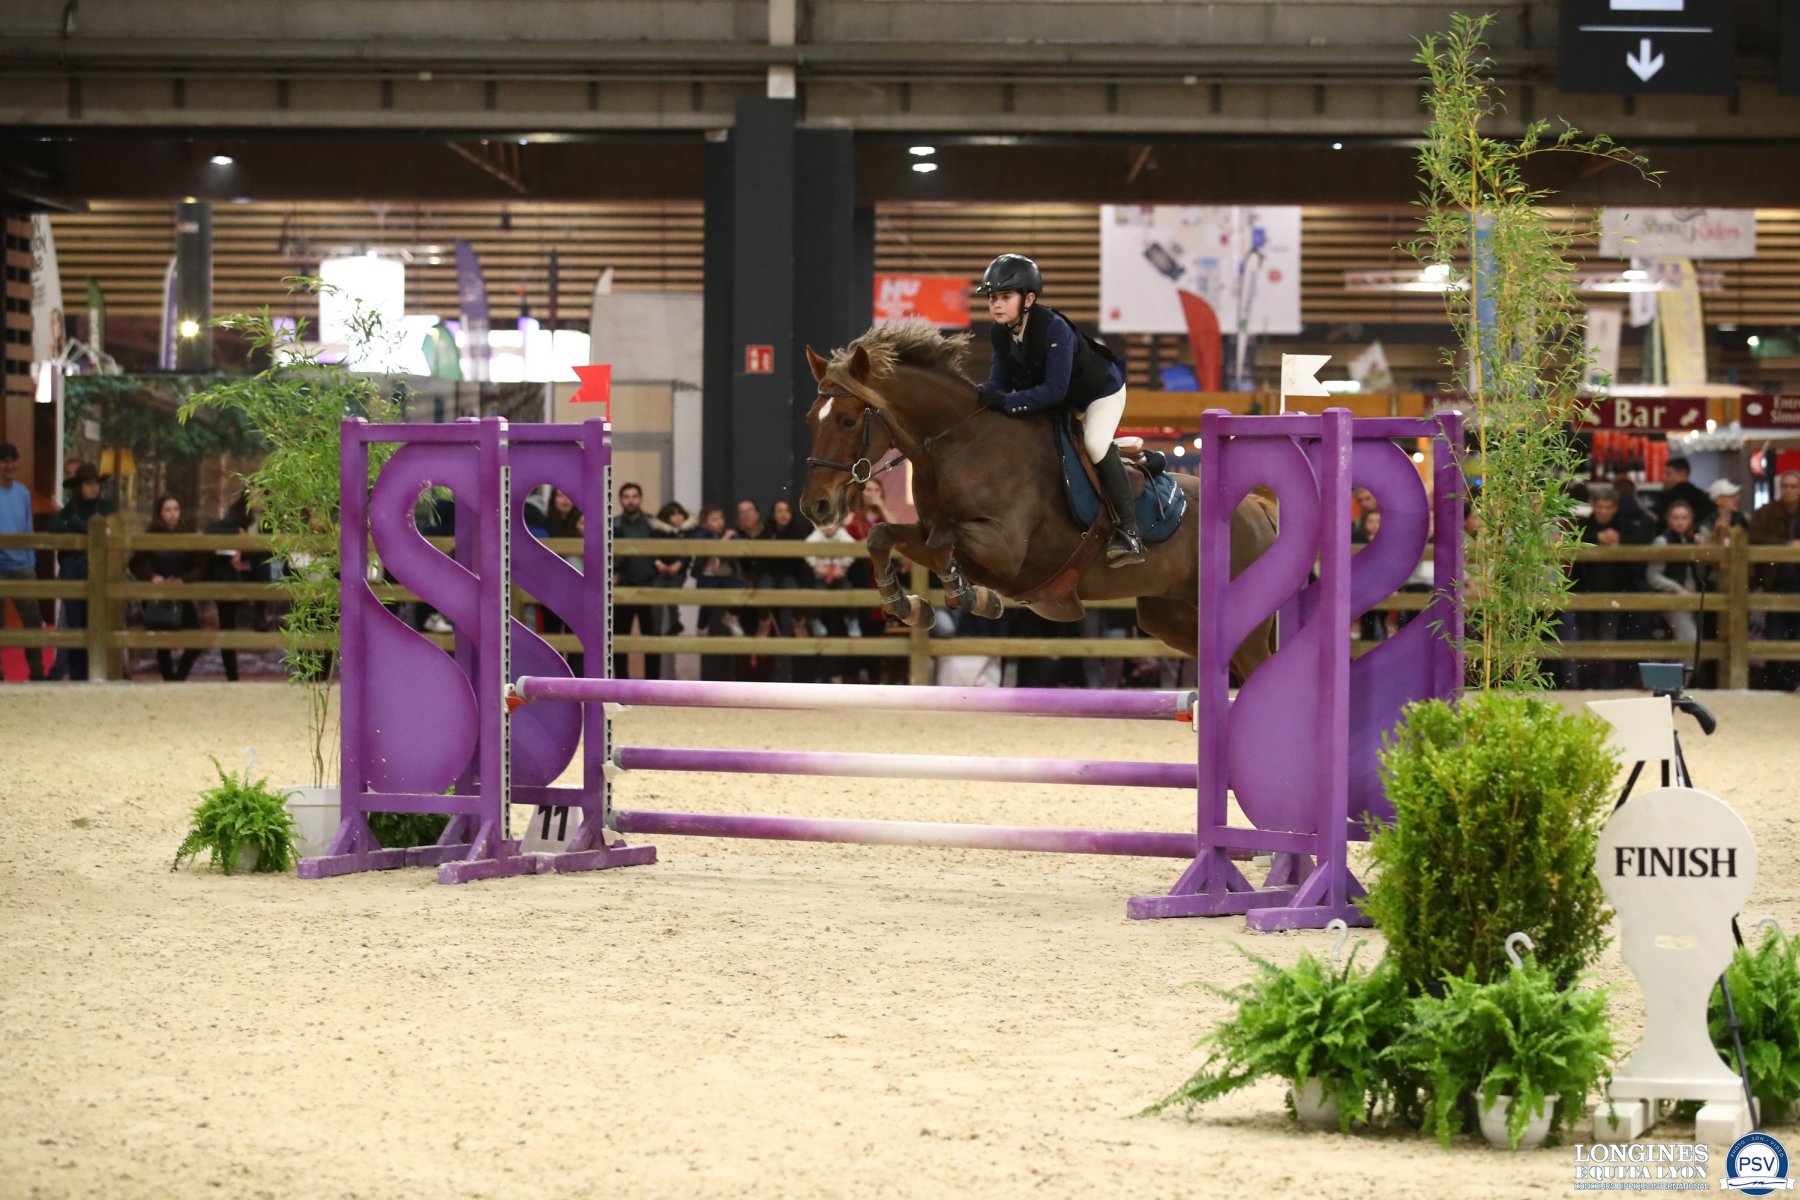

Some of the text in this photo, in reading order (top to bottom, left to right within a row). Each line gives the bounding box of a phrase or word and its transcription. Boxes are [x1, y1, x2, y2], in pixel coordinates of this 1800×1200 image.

[1614, 398, 1667, 427] Bar
[538, 804, 569, 841] 11
[1614, 846, 1738, 878] FINISH
